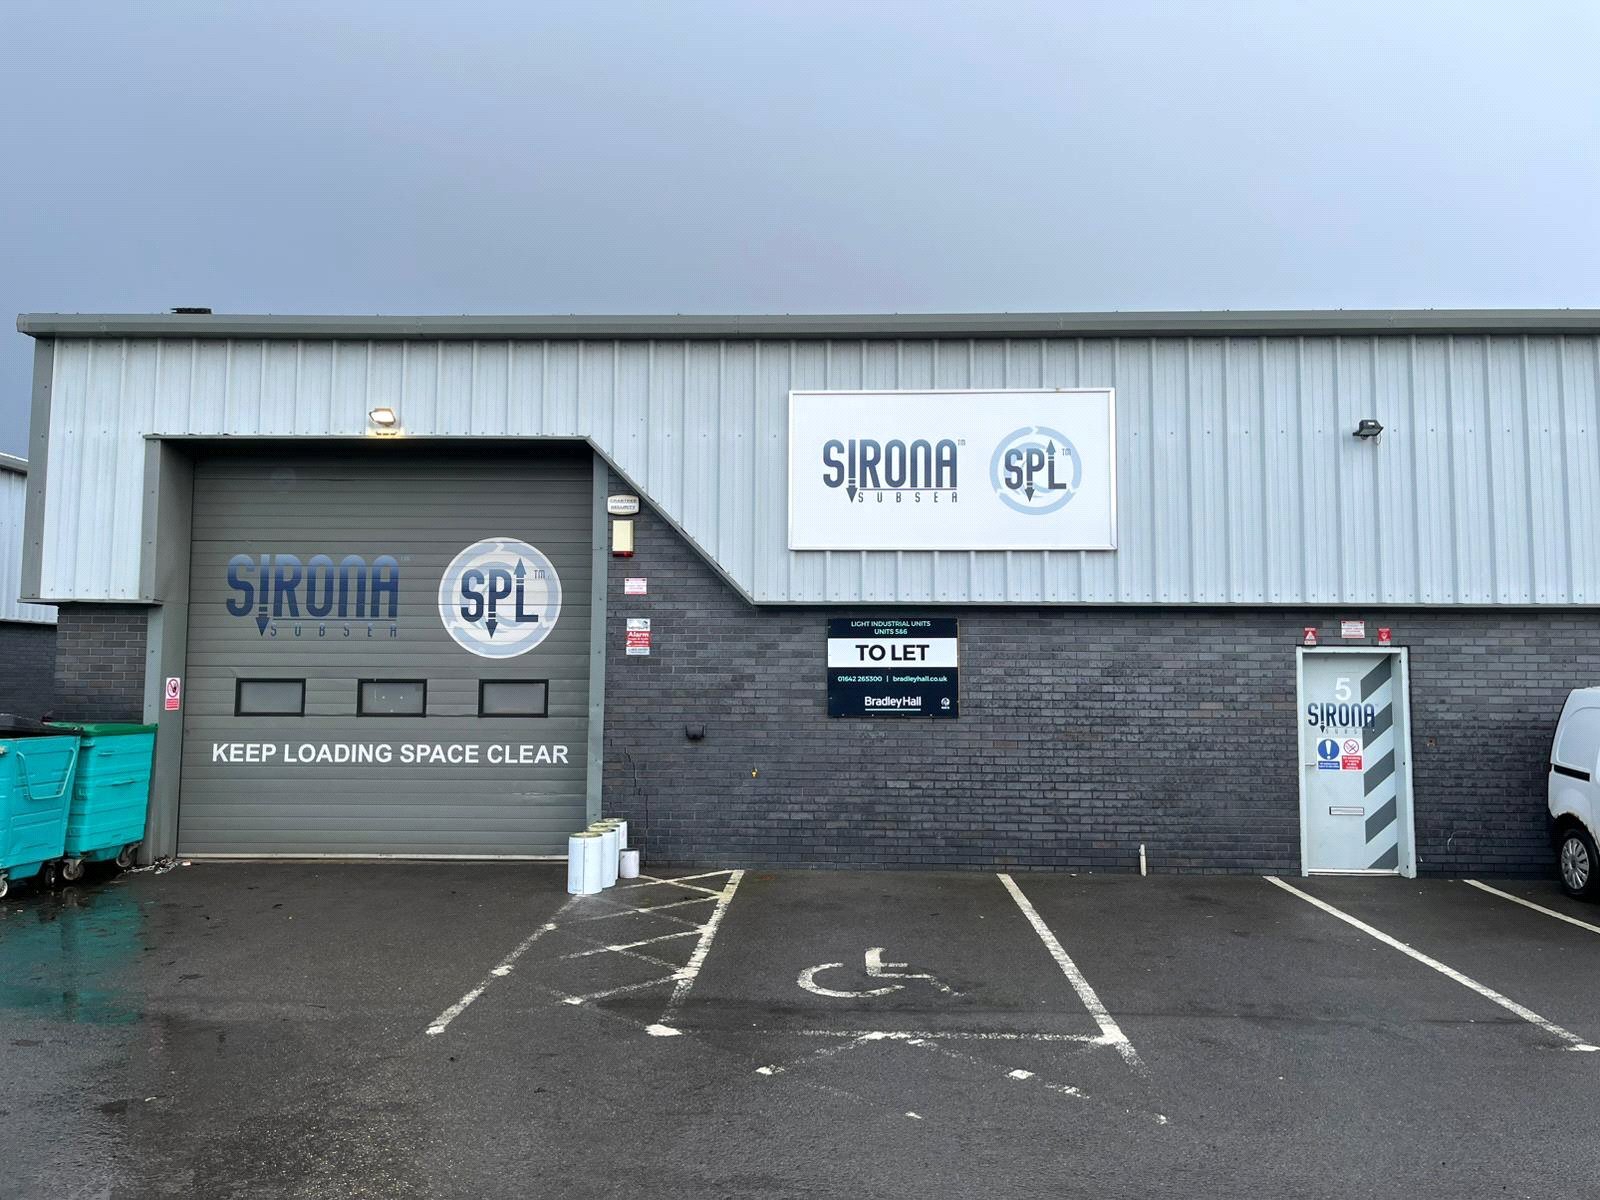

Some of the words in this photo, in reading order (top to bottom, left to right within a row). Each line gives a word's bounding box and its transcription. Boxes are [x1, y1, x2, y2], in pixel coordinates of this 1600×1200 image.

[823, 439, 957, 489] SIRONA
[1004, 440, 1067, 502] SPL
[858, 491, 958, 503] SUBSEA
[226, 553, 399, 618] SIRONA
[460, 557, 539, 639] SPL
[270, 623, 398, 638] SUBSEA
[855, 645, 886, 661] TO
[891, 644, 930, 661] LET
[892, 675, 948, 683] bradleyhall.co.uk
[1335, 677, 1351, 700] 5
[864, 696, 902, 708] Bradley
[902, 696, 922, 706] Hall
[1307, 703, 1375, 727] SIRONA
[212, 744, 277, 763] KEEP
[283, 744, 393, 763] LOADING
[399, 744, 480, 764] SPACE
[486, 744, 569, 764] CLEAR
